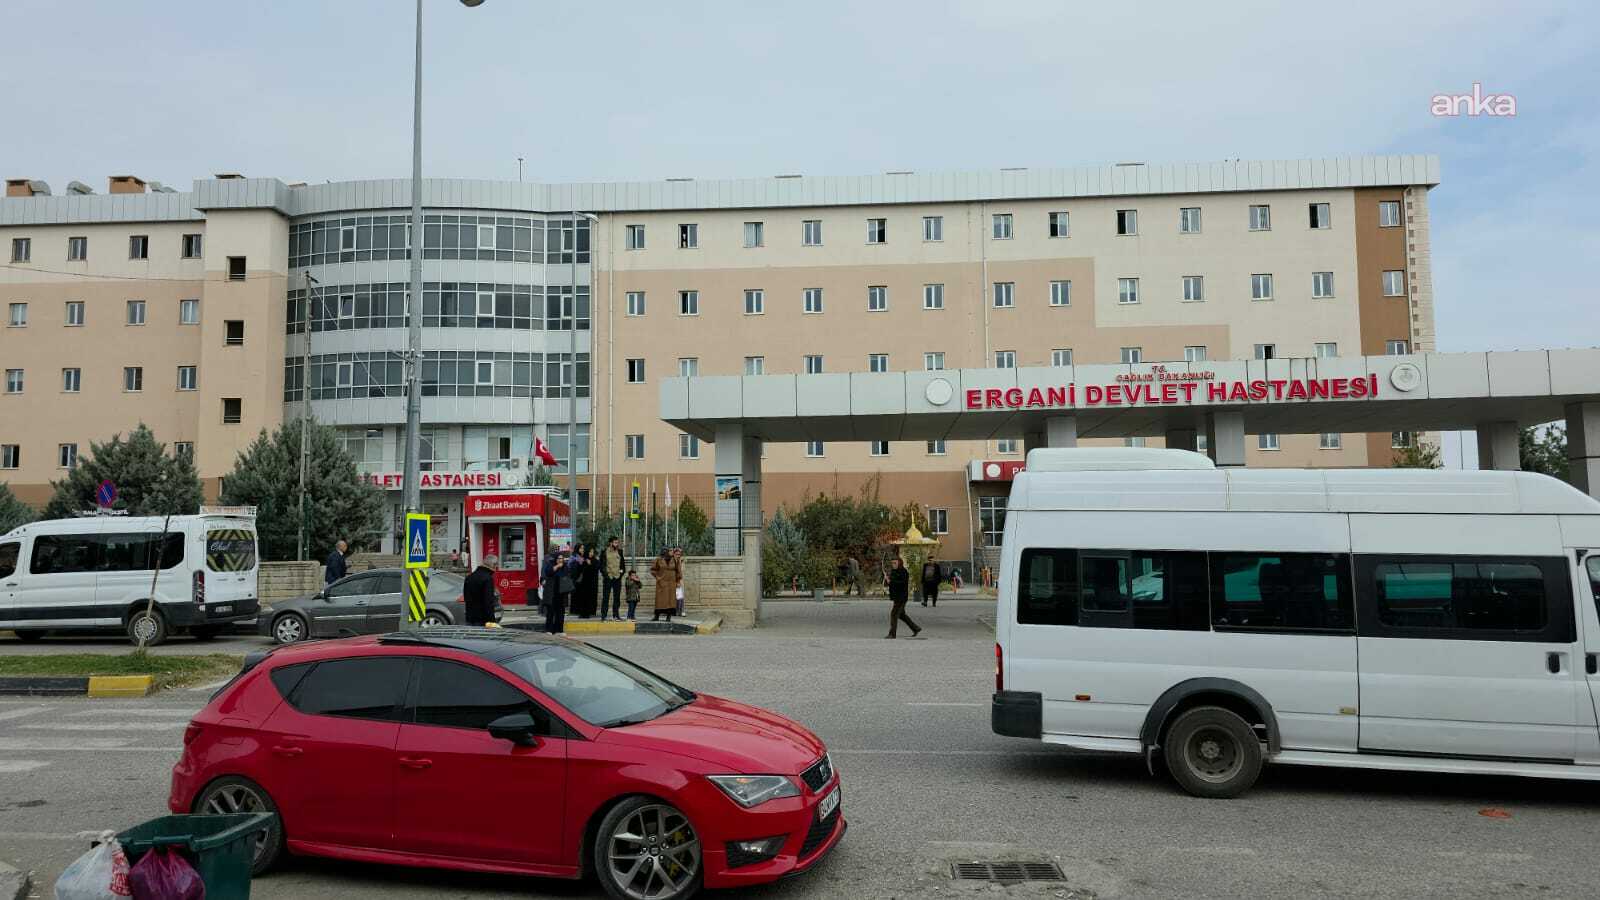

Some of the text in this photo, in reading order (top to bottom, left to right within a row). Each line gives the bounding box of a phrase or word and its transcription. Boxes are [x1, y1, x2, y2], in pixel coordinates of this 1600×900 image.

[966, 373, 1378, 410] ERGANİ DEVLET HASTANESİ
[421, 472, 501, 487] ASTANESİ
